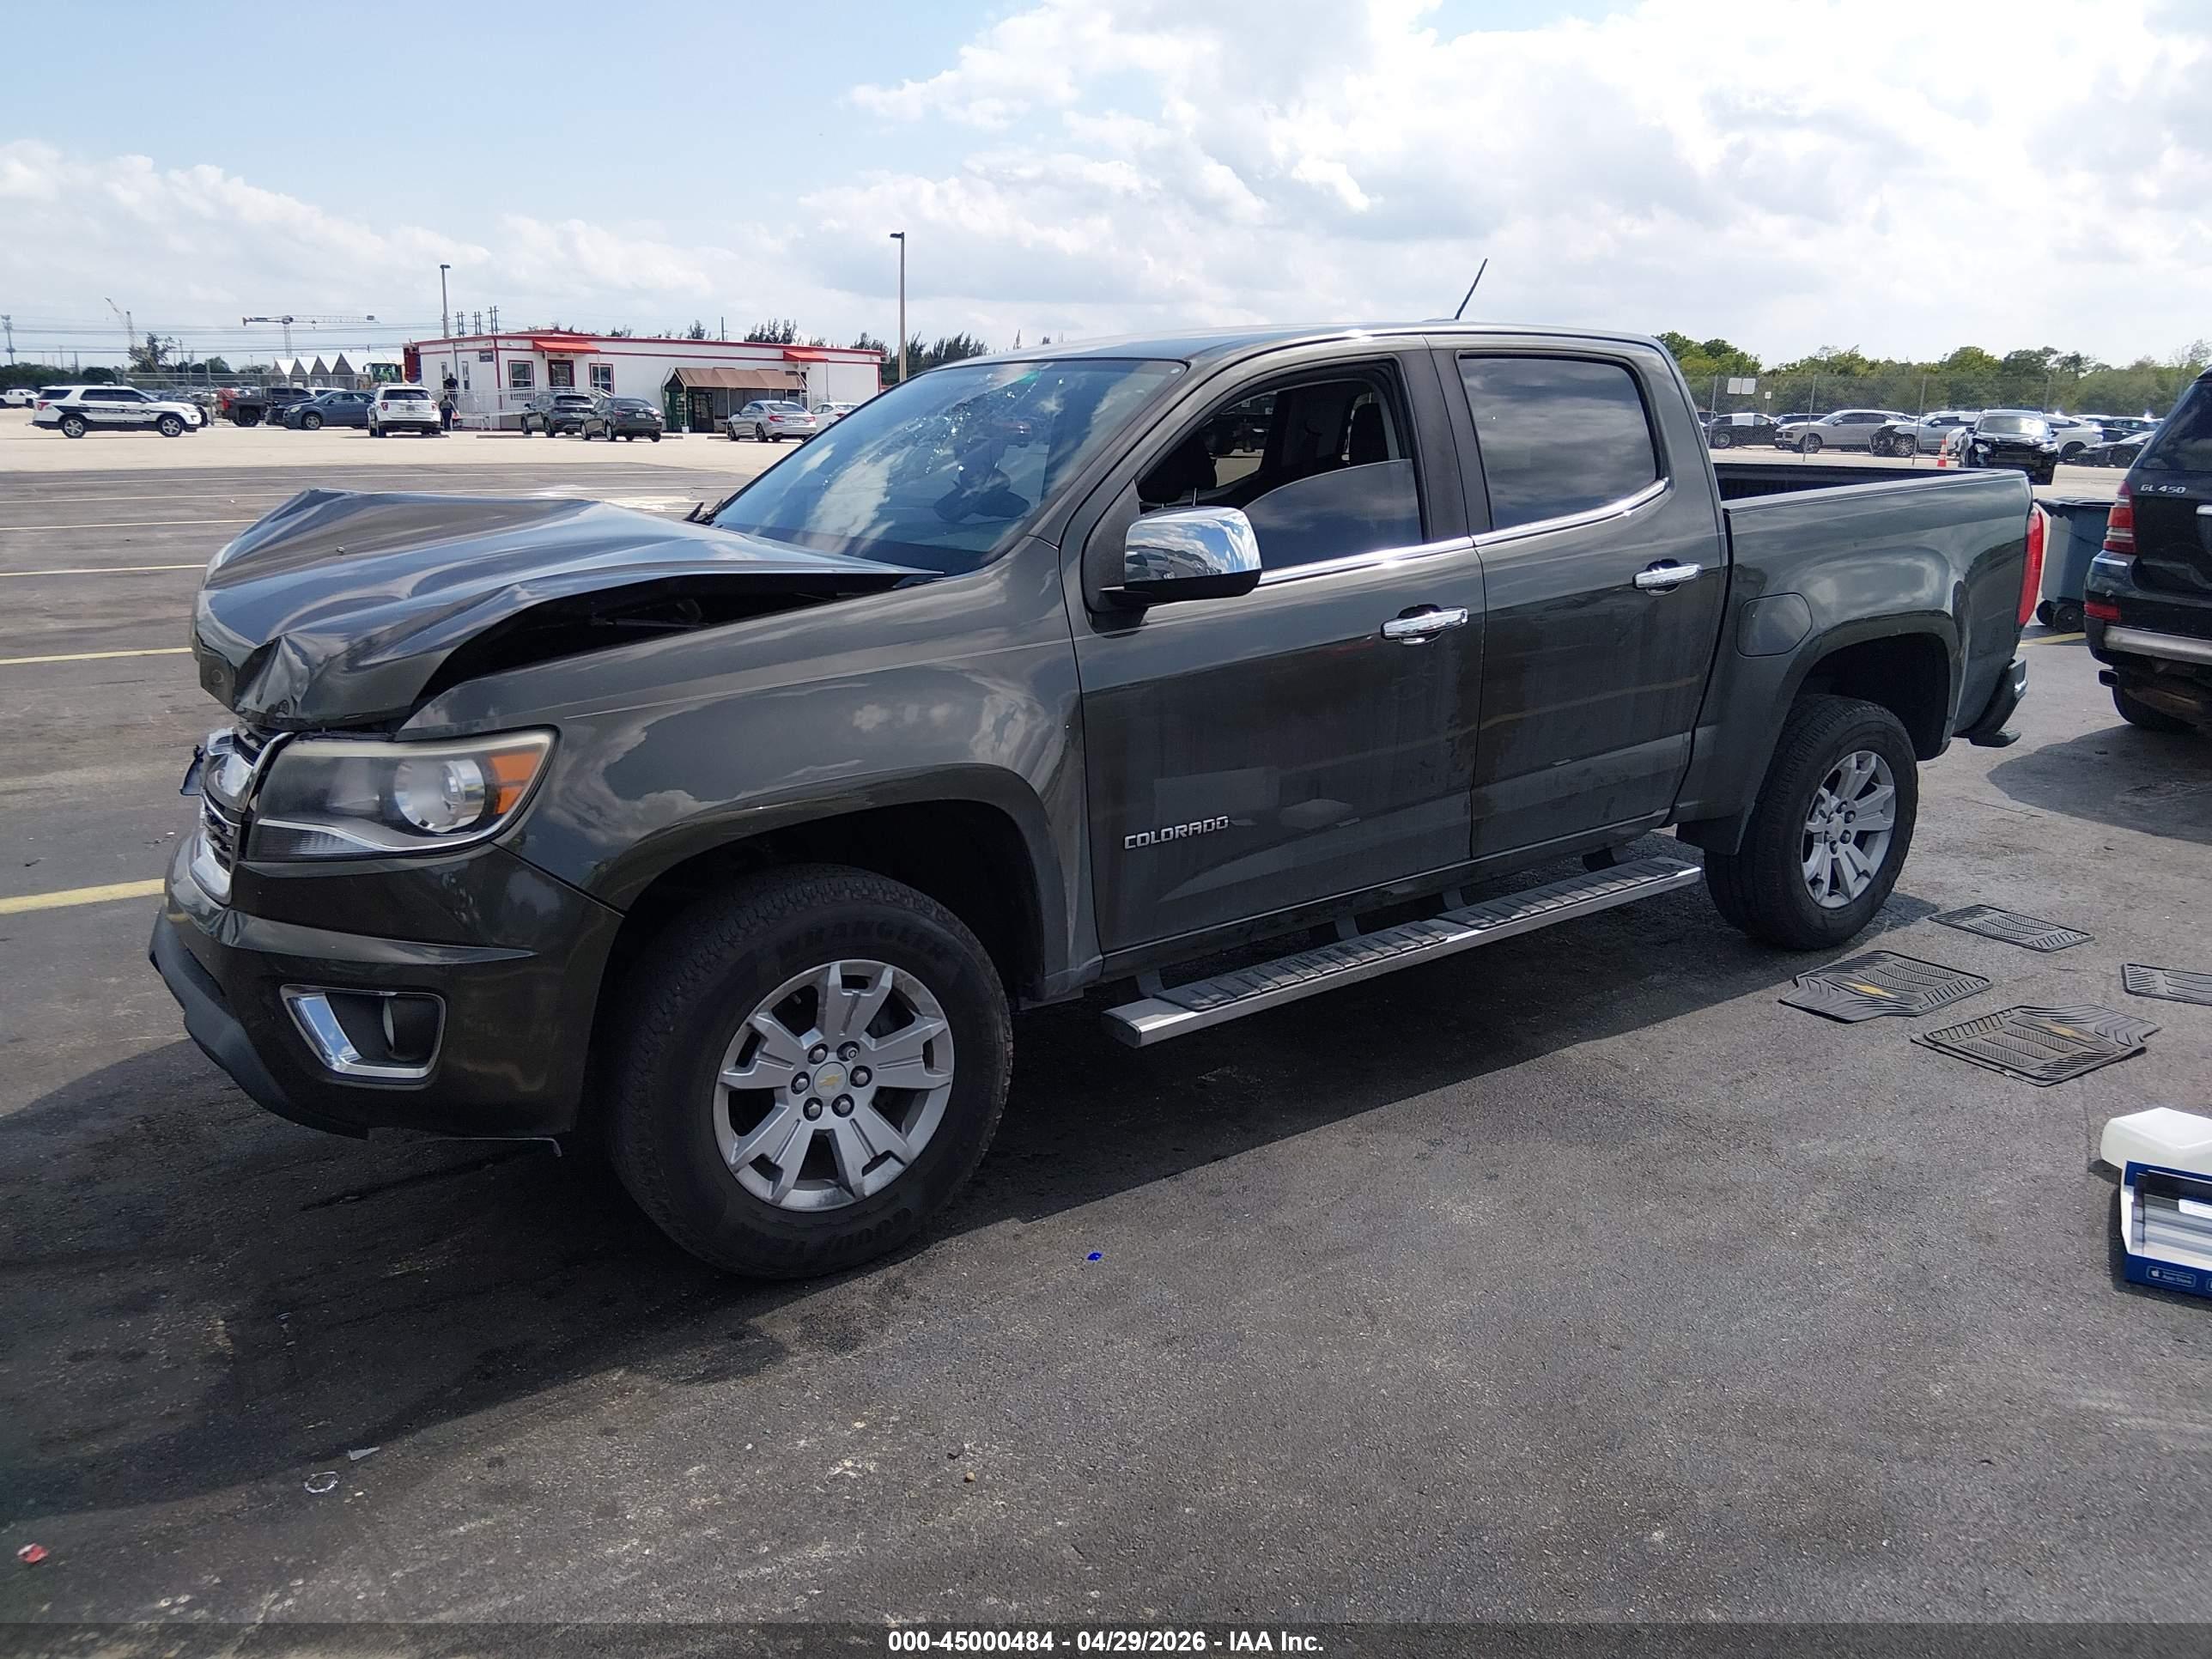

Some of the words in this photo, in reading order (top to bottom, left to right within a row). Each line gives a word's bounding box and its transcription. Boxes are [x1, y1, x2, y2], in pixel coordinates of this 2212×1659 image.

[2140, 483, 2155, 492] GL
[2157, 484, 2187, 494] 450
[1124, 815, 1229, 850] COLORADO
